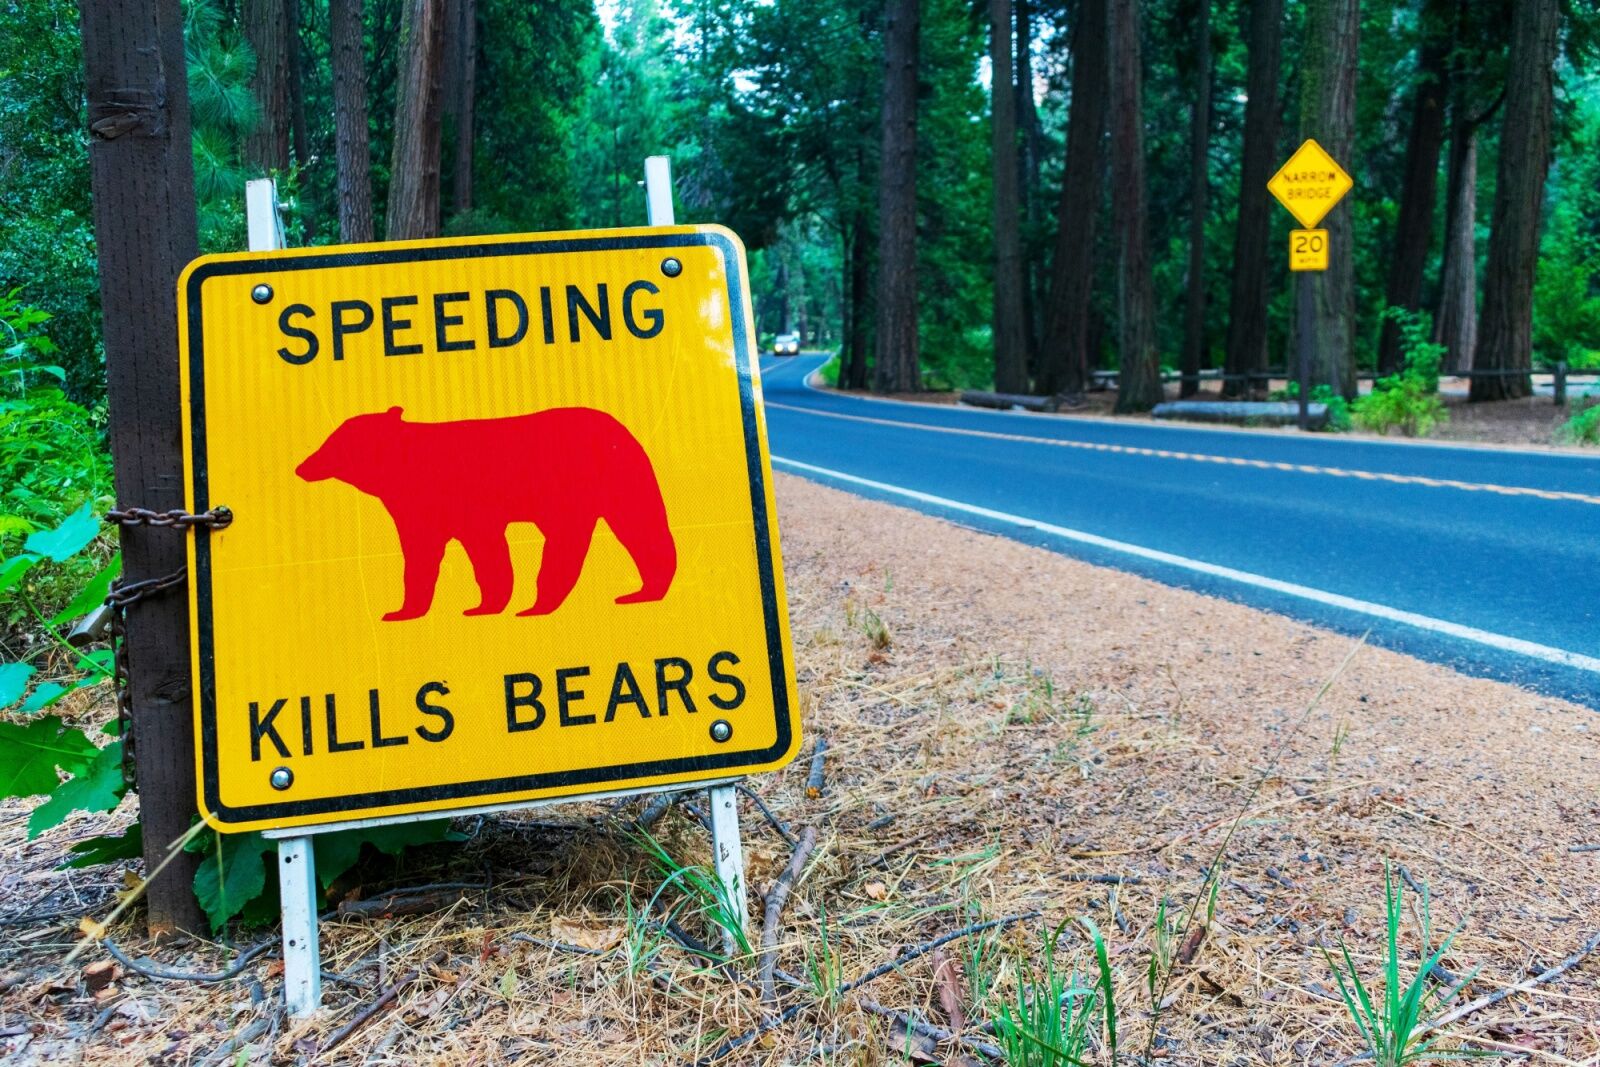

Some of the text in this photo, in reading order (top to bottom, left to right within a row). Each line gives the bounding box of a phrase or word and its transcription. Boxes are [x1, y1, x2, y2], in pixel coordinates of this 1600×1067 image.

[1283, 171, 1336, 183] NARROW
[1287, 187, 1332, 200] BRIDGE
[1295, 236, 1323, 253] 20
[277, 280, 665, 365] SPEEDING
[249, 651, 746, 762] KILLS BEARS
